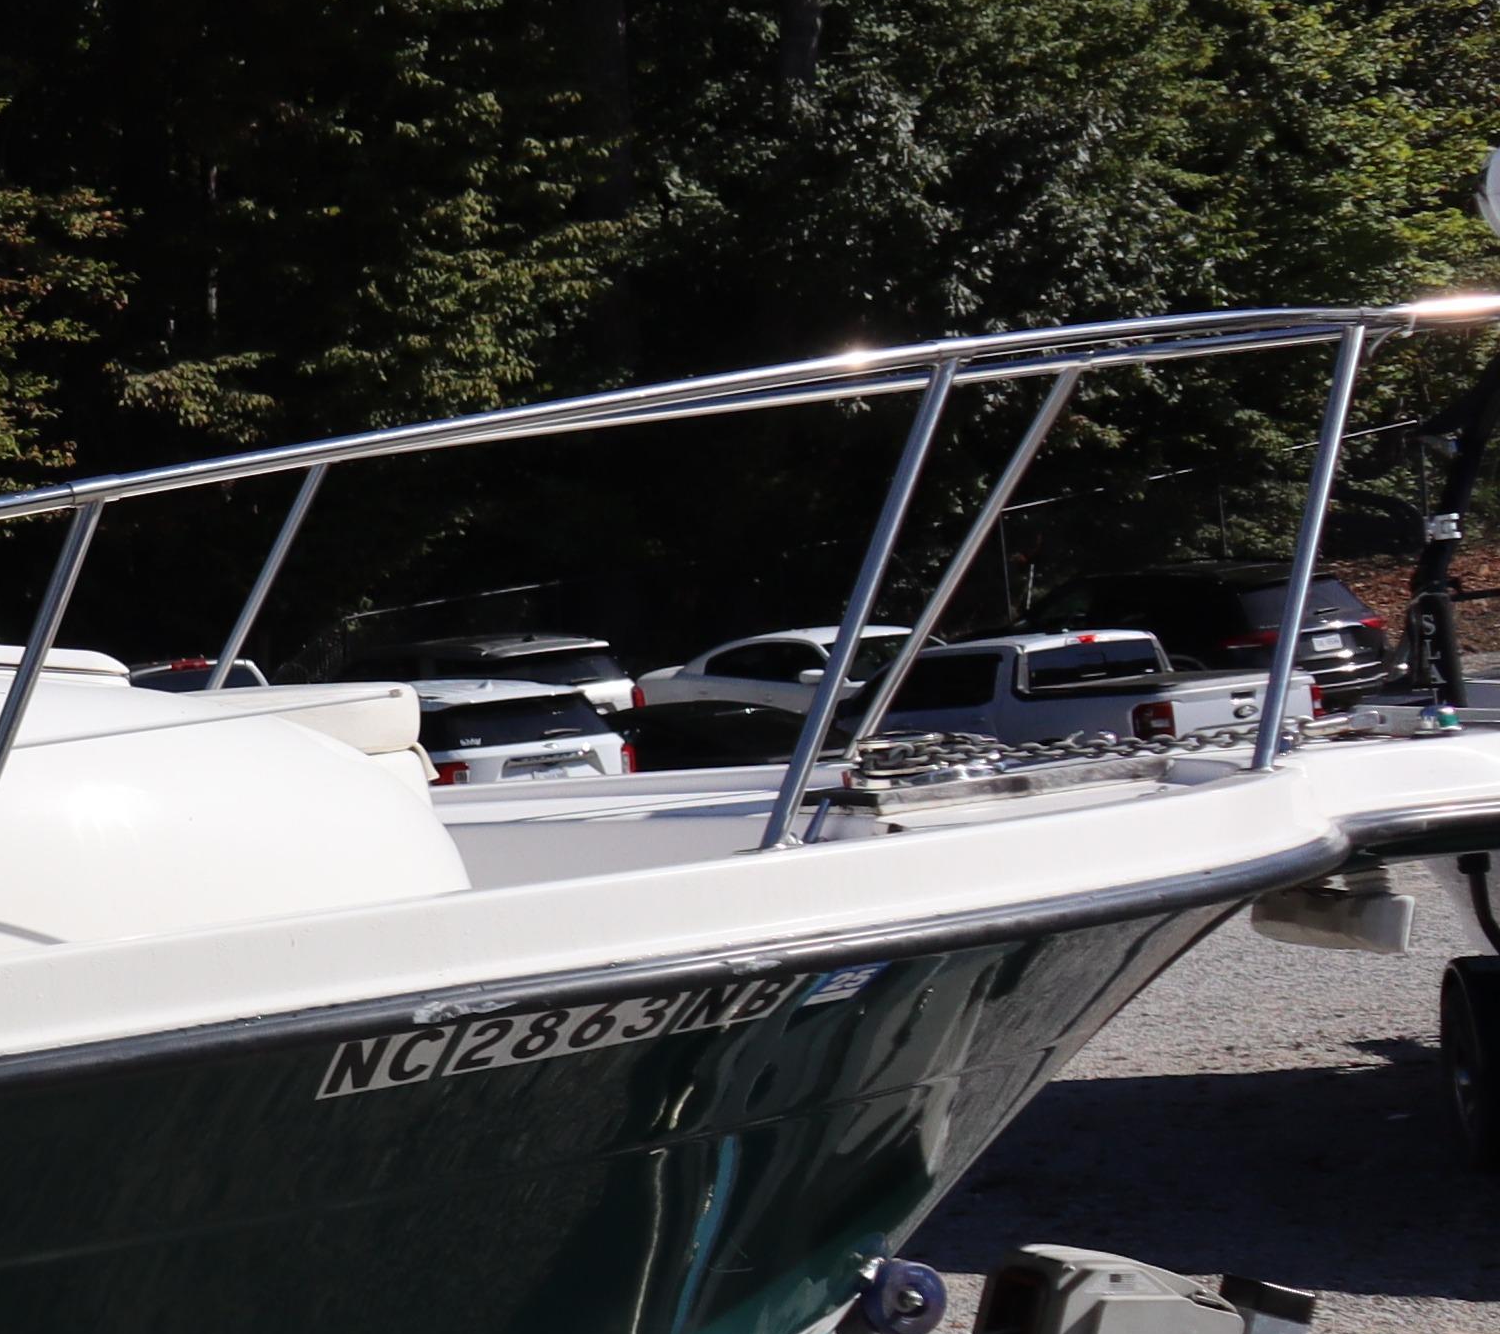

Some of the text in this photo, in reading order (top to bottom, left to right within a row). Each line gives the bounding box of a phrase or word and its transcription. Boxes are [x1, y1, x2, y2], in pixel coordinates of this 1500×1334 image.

[819, 968, 878, 993] 25
[324, 1027, 447, 1094] NC
[455, 992, 682, 1069] 2863
